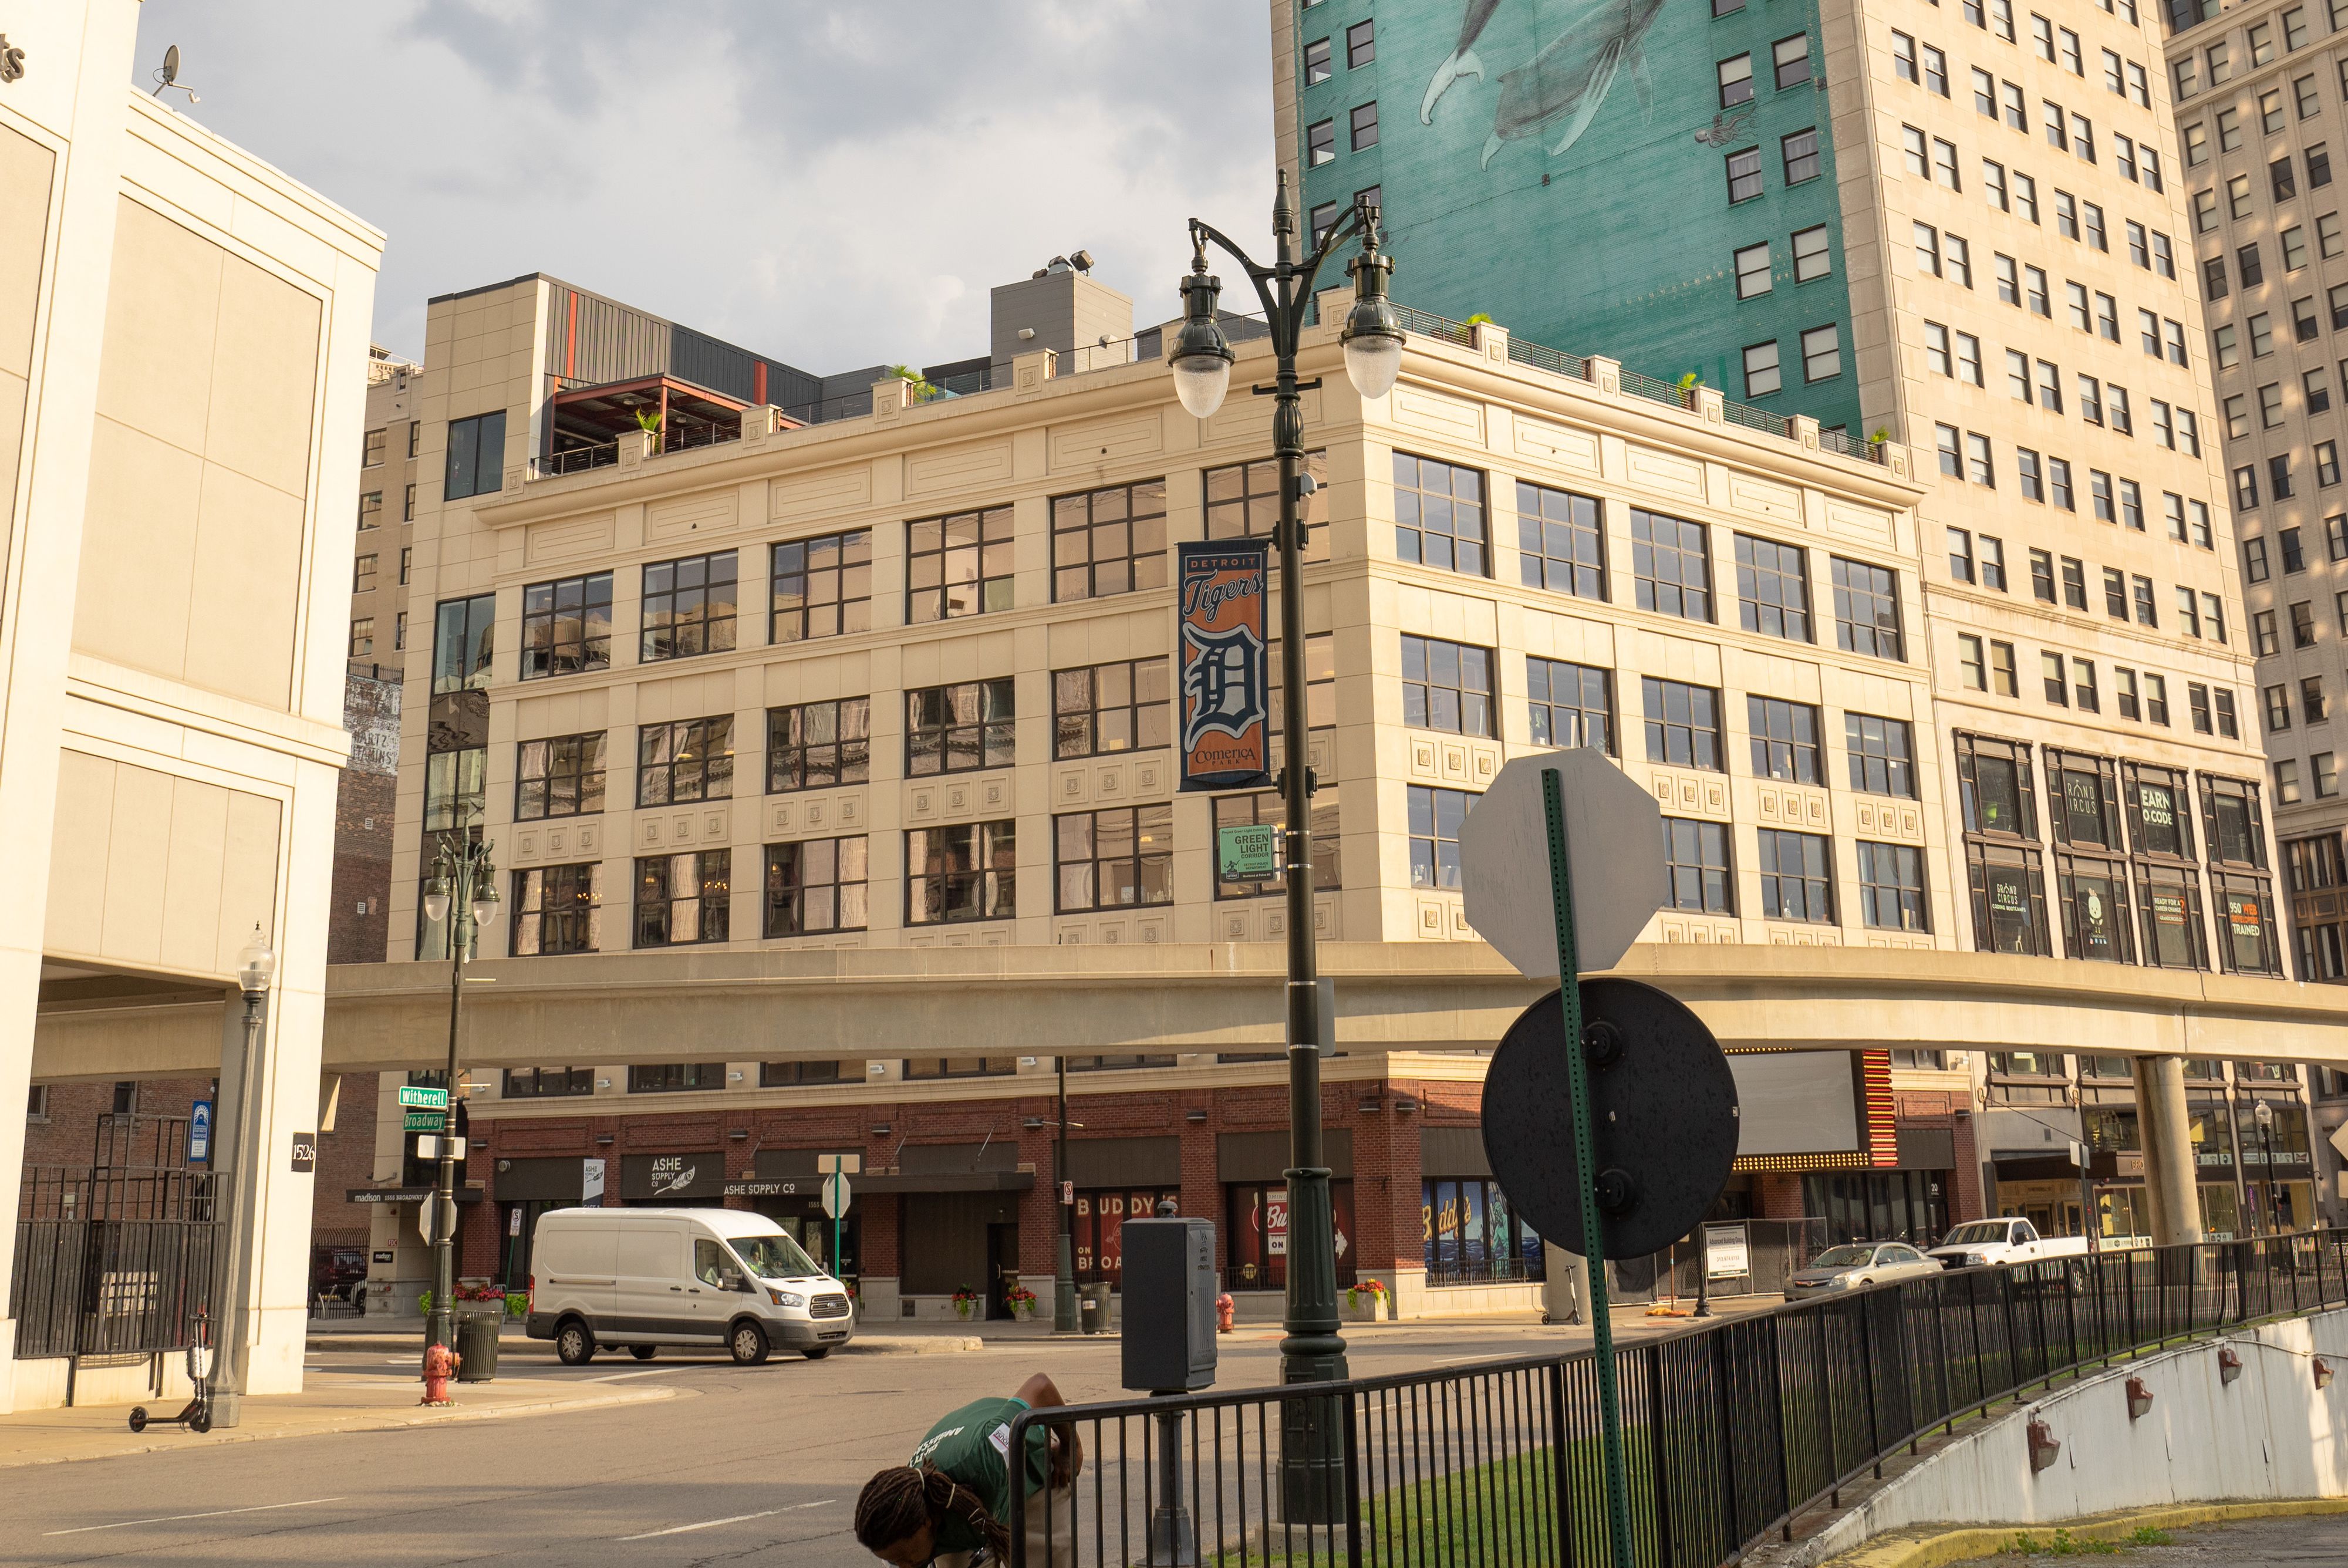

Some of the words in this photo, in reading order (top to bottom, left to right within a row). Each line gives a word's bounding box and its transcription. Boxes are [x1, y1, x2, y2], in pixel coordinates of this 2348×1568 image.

[1190, 558, 1256, 568] DETROIT
[1182, 568, 1264, 623] Tigers
[1182, 621, 1266, 753] D
[2150, 811, 2172, 825] CODE
[1234, 834, 1269, 844] GREEN
[1240, 843, 1269, 854] LIGHT
[1996, 883, 2017, 895] GRAND
[1997, 893, 2018, 905] CIRCUS
[2229, 902, 2242, 914] 950
[2242, 903, 2258, 915] WEB
[2231, 915, 2259, 925] DEVELOPERS
[2232, 923, 2260, 936] TRAINED
[402, 1089, 444, 1105] Witherell
[404, 1114, 444, 1129] Broadway
[294, 1144, 315, 1161] 1526
[652, 1157, 682, 1172] ASHE
[652, 1172, 676, 1181] SUPPLY
[724, 1185, 745, 1195] ASHE
[748, 1183, 780, 1194] SUPPLY
[1931, 1183, 1938, 1192] 20
[355, 1193, 381, 1202] madison
